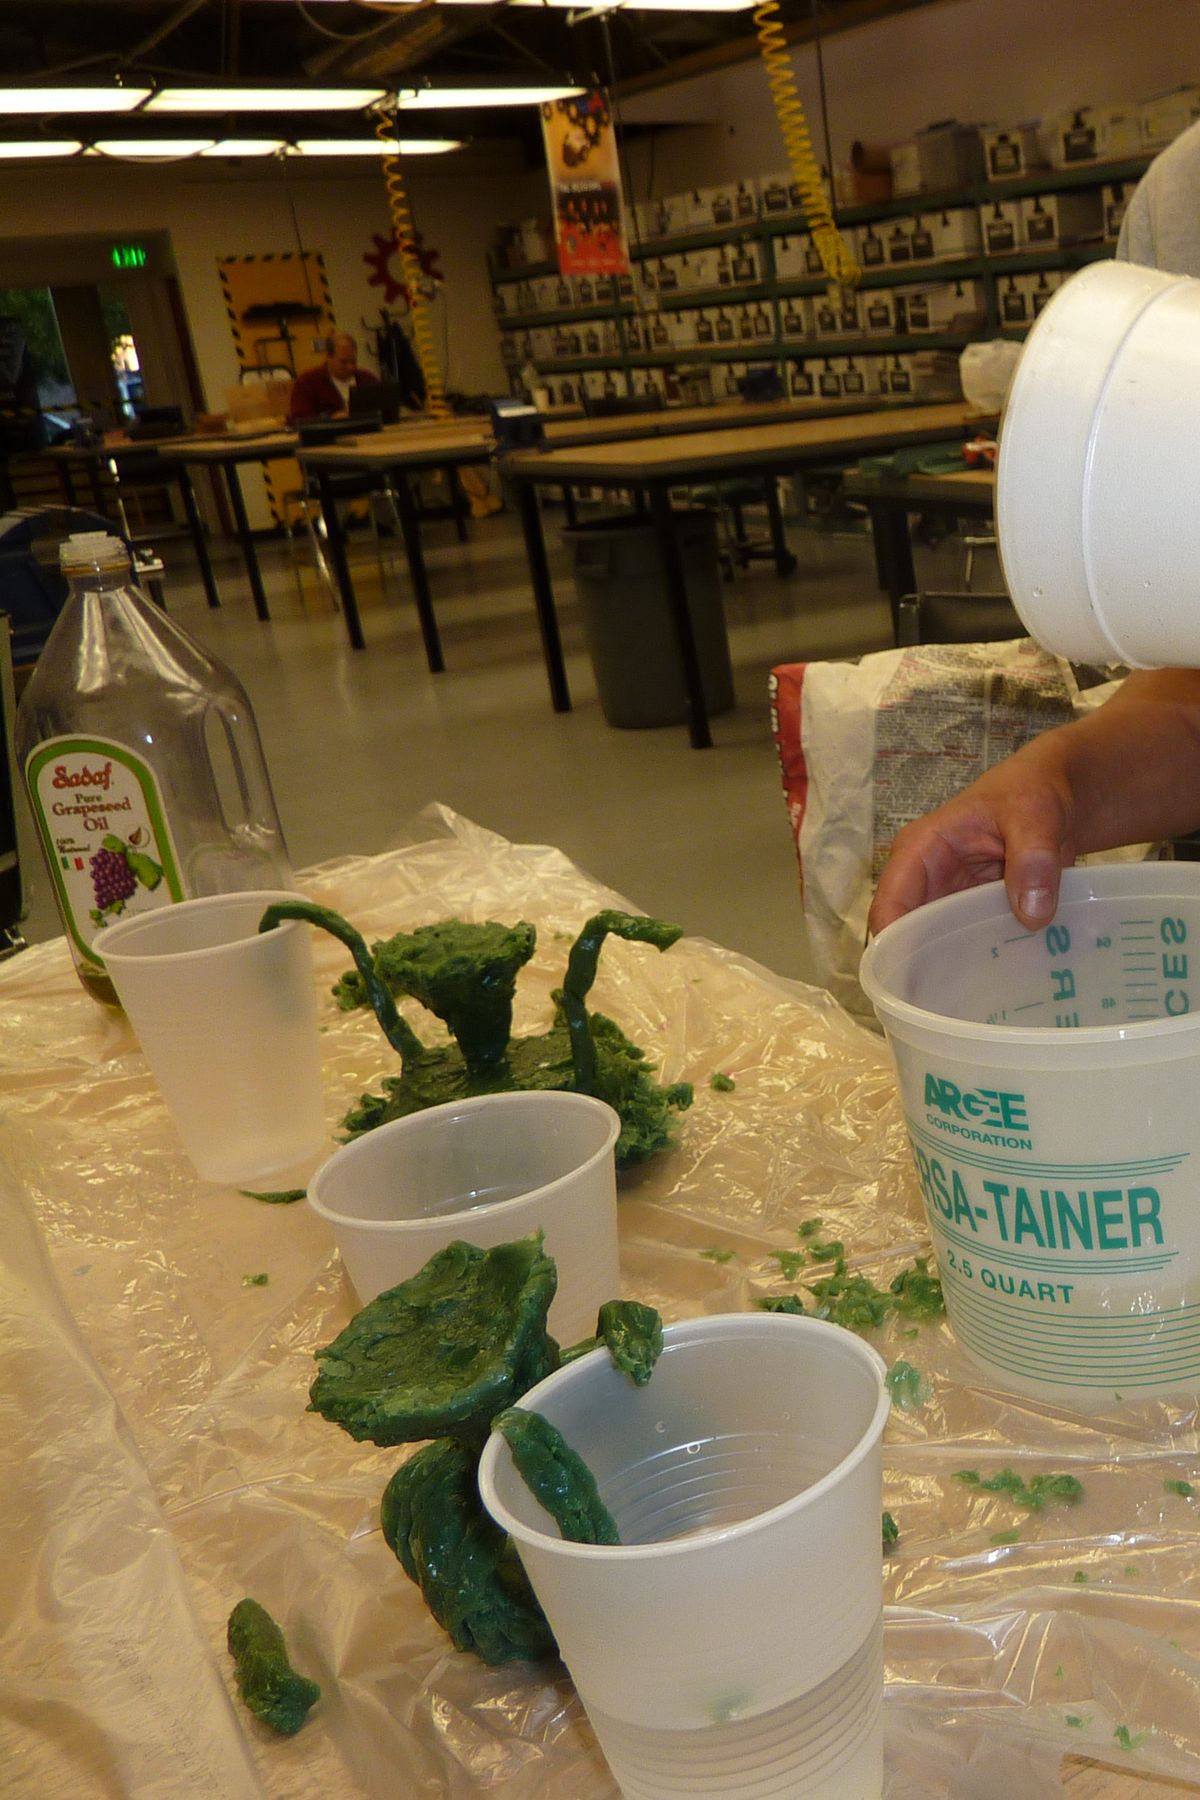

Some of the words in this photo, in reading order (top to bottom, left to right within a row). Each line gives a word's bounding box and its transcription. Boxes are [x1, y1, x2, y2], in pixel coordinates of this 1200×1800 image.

[52, 797, 132, 817] Grapeseed
[75, 793, 102, 804] Pure
[83, 816, 109, 831] Oil
[924, 1073, 1030, 1131] ARGEE
[926, 1114, 1033, 1150] CORPORATION
[947, 1249, 973, 1279] 2.5
[981, 1268, 1074, 1304] QUART
